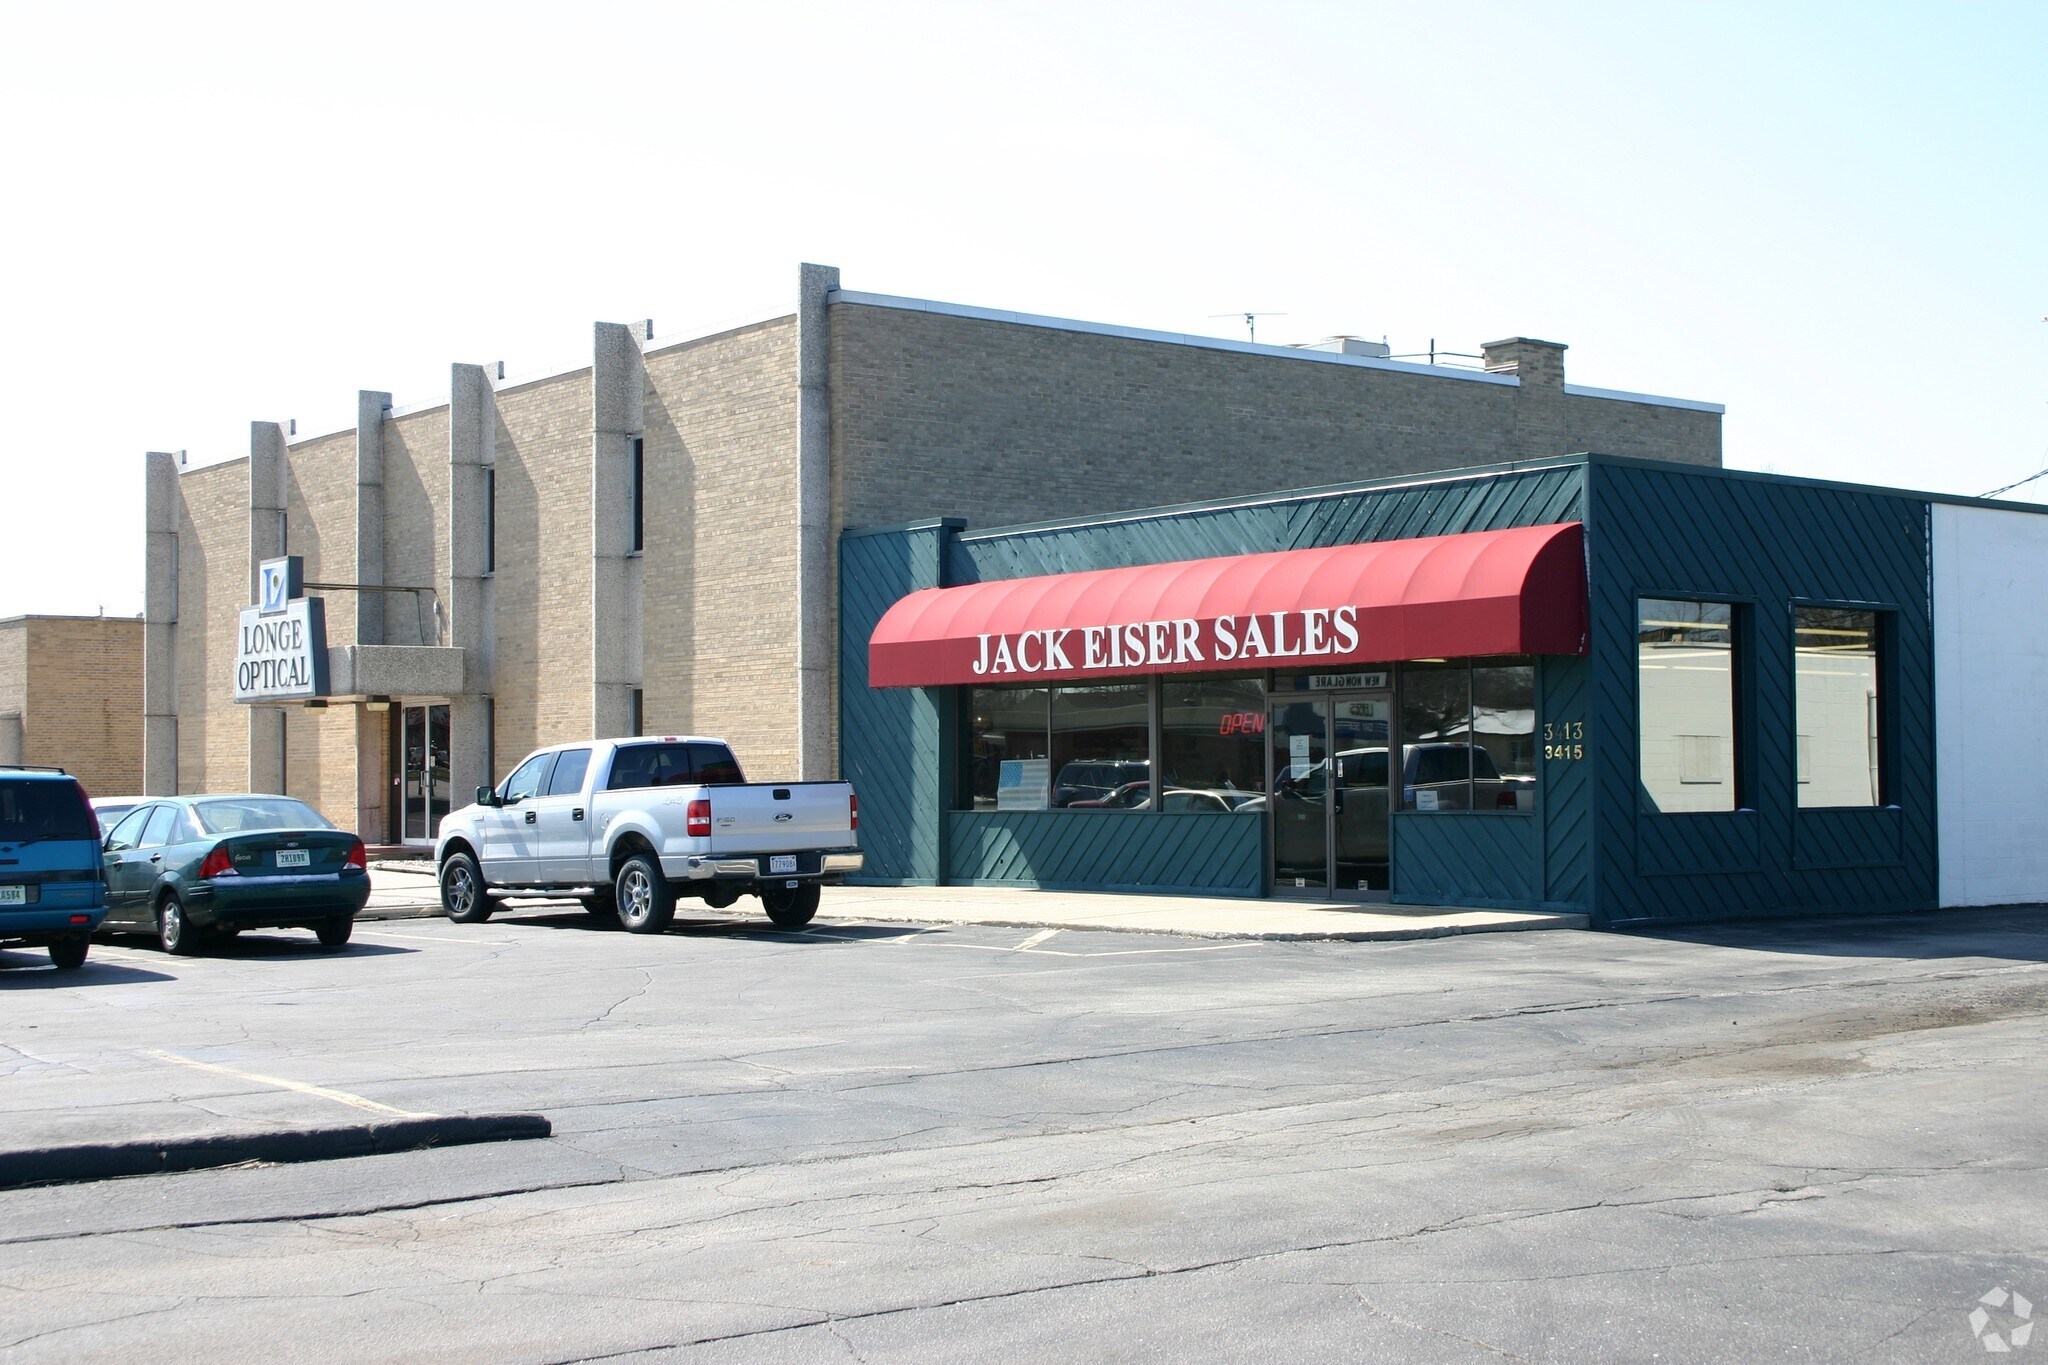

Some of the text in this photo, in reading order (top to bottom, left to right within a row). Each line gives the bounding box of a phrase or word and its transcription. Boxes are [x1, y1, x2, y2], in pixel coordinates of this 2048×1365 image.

[243, 619, 302, 655] LONGE
[972, 605, 1359, 675] JACK EISER SALES
[238, 656, 310, 691] OPTICAL
[1220, 712, 1265, 735] OPEN
[1544, 744, 1583, 760] 3415
